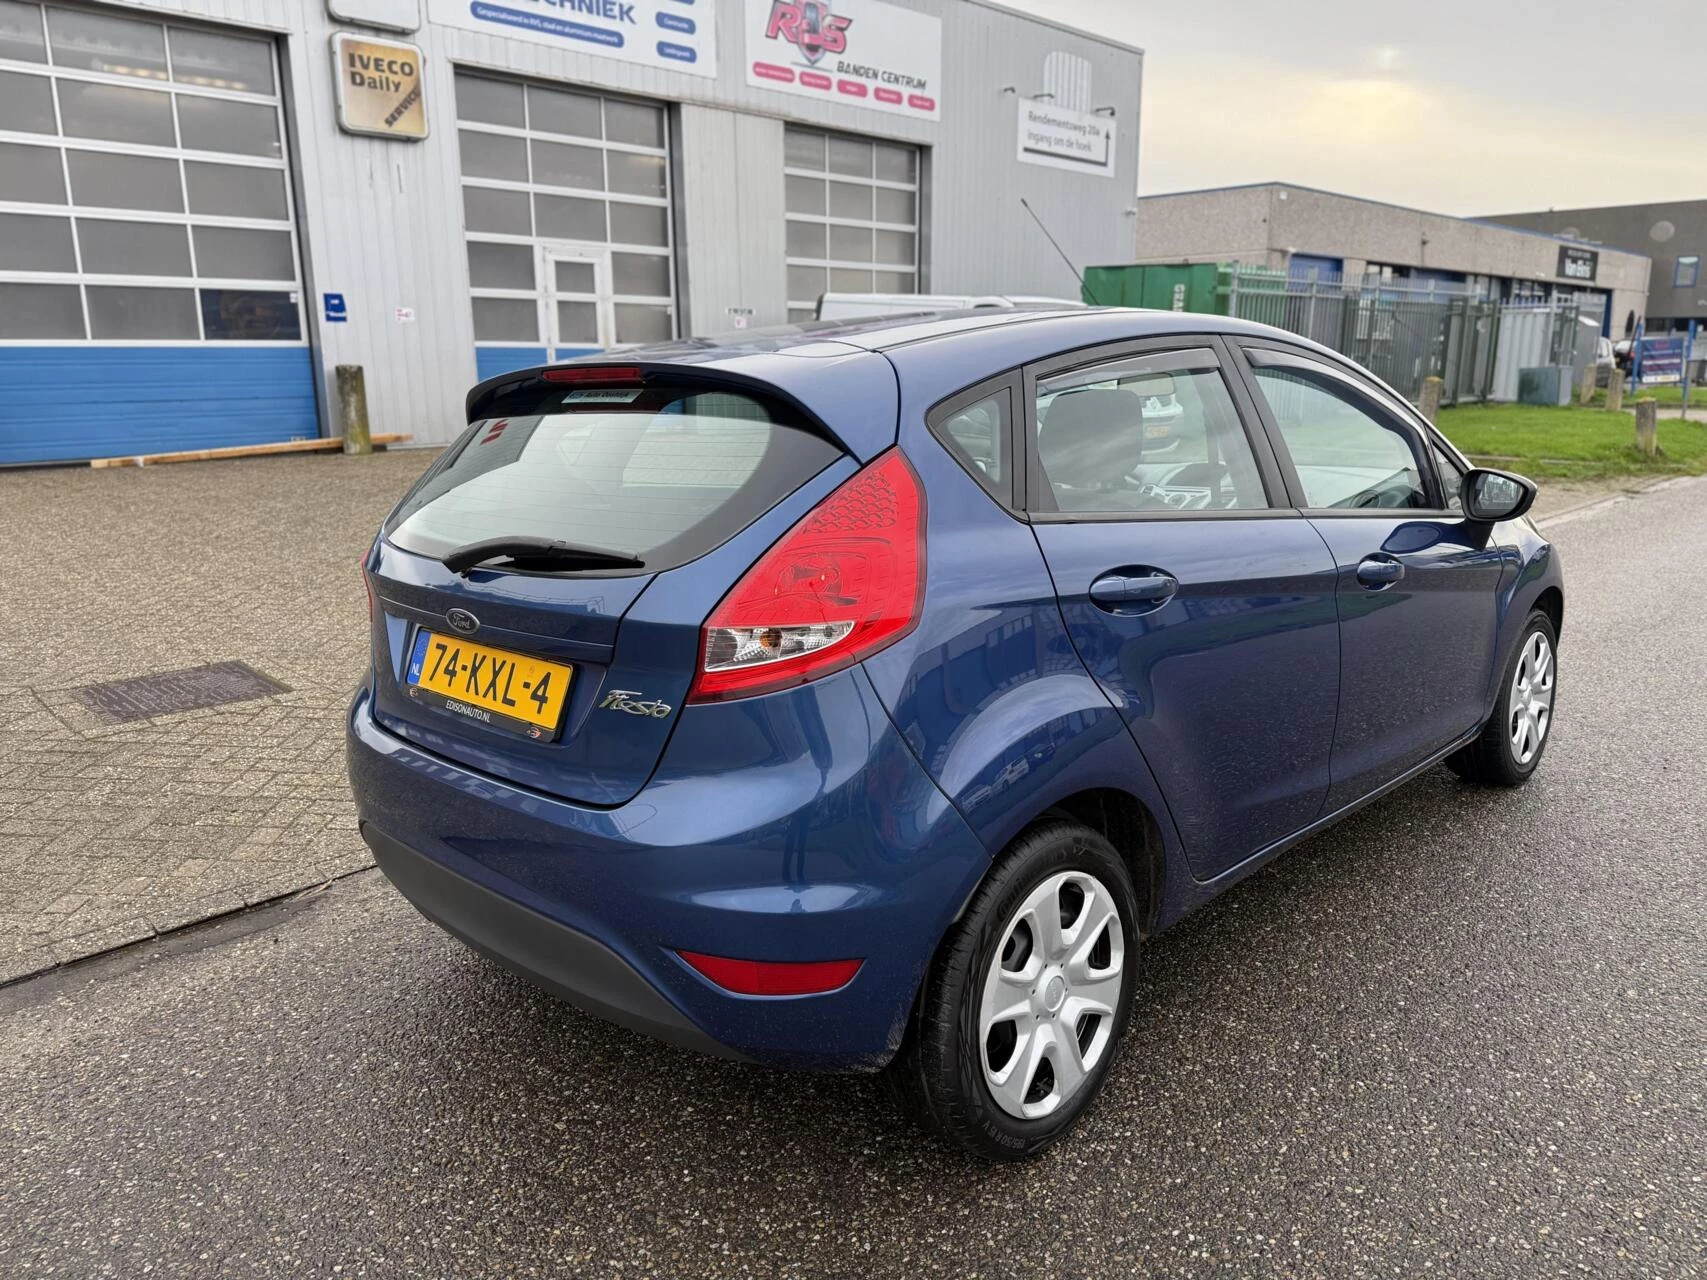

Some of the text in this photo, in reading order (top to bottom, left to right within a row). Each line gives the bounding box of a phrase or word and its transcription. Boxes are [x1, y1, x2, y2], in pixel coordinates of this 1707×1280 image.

[348, 52, 414, 77] IVECO
[837, 60, 879, 80] BANDEN
[881, 70, 927, 90] CENTRUM
[350, 70, 401, 93] Daily
[451, 611, 472, 629] Ford
[411, 642, 552, 715] NL 74-KXL-4
[445, 699, 491, 723] EDISONAUTO.NL
[599, 689, 672, 719] Fiesta
